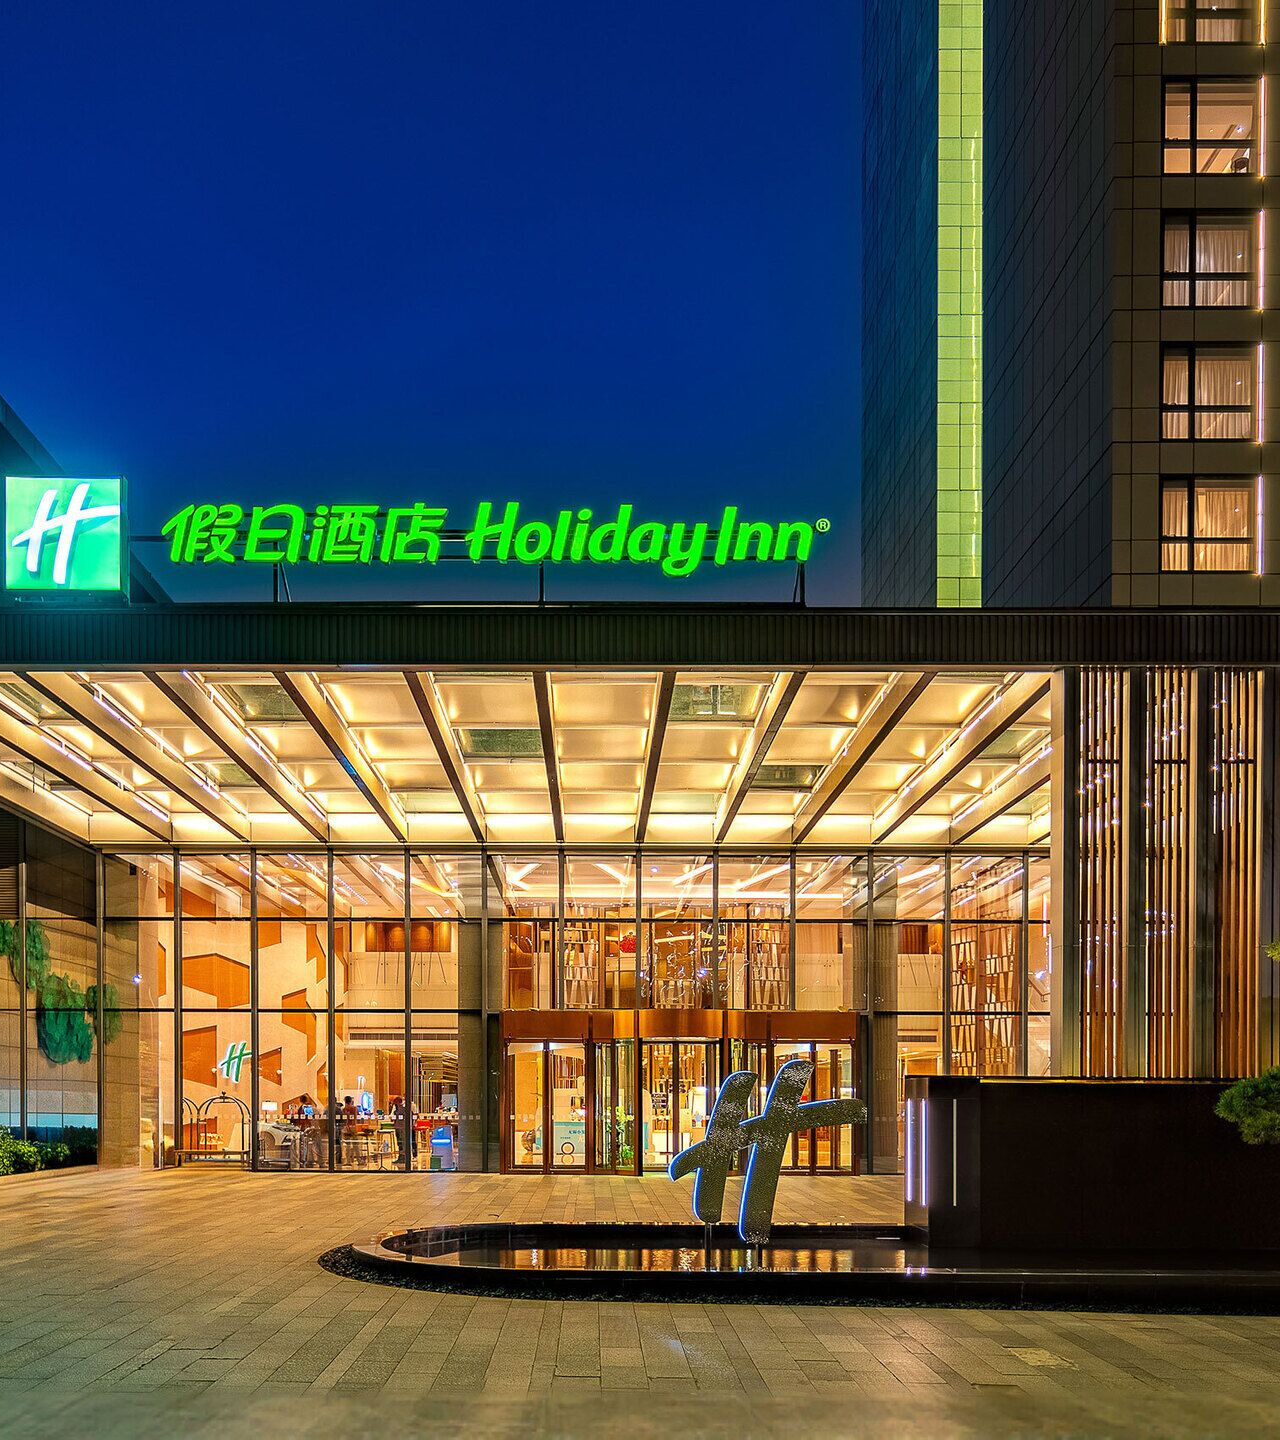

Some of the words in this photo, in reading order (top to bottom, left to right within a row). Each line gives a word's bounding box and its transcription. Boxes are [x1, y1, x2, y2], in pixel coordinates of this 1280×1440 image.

[161, 503, 448, 564] 假日酒店
[465, 501, 708, 577] Holiday
